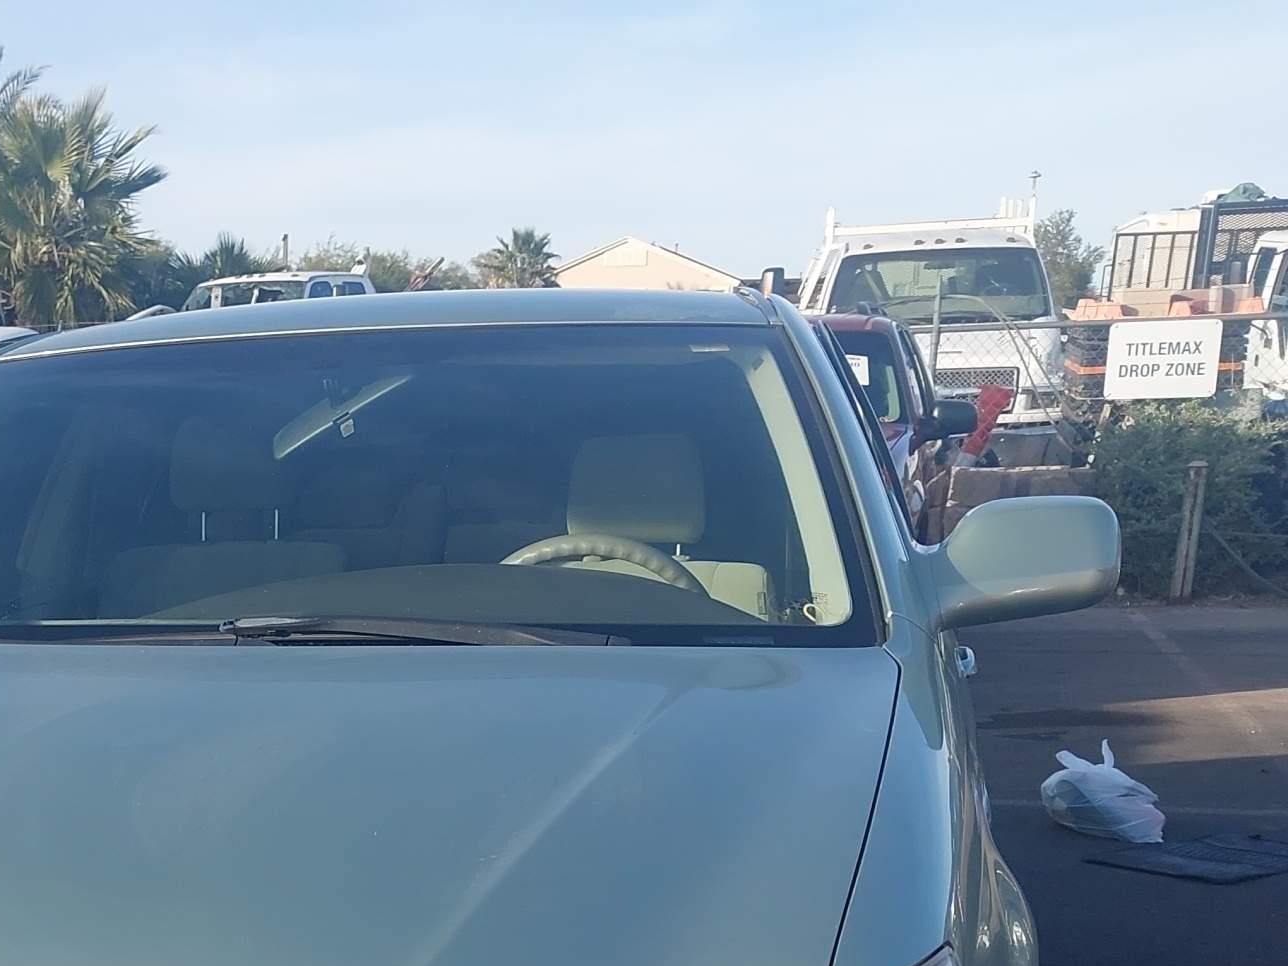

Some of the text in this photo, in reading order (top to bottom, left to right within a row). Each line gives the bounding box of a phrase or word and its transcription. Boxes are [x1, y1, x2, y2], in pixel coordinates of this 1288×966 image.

[1125, 341, 1203, 357] TITLEMAX
[1118, 362, 1207, 378] DROP ZONE
